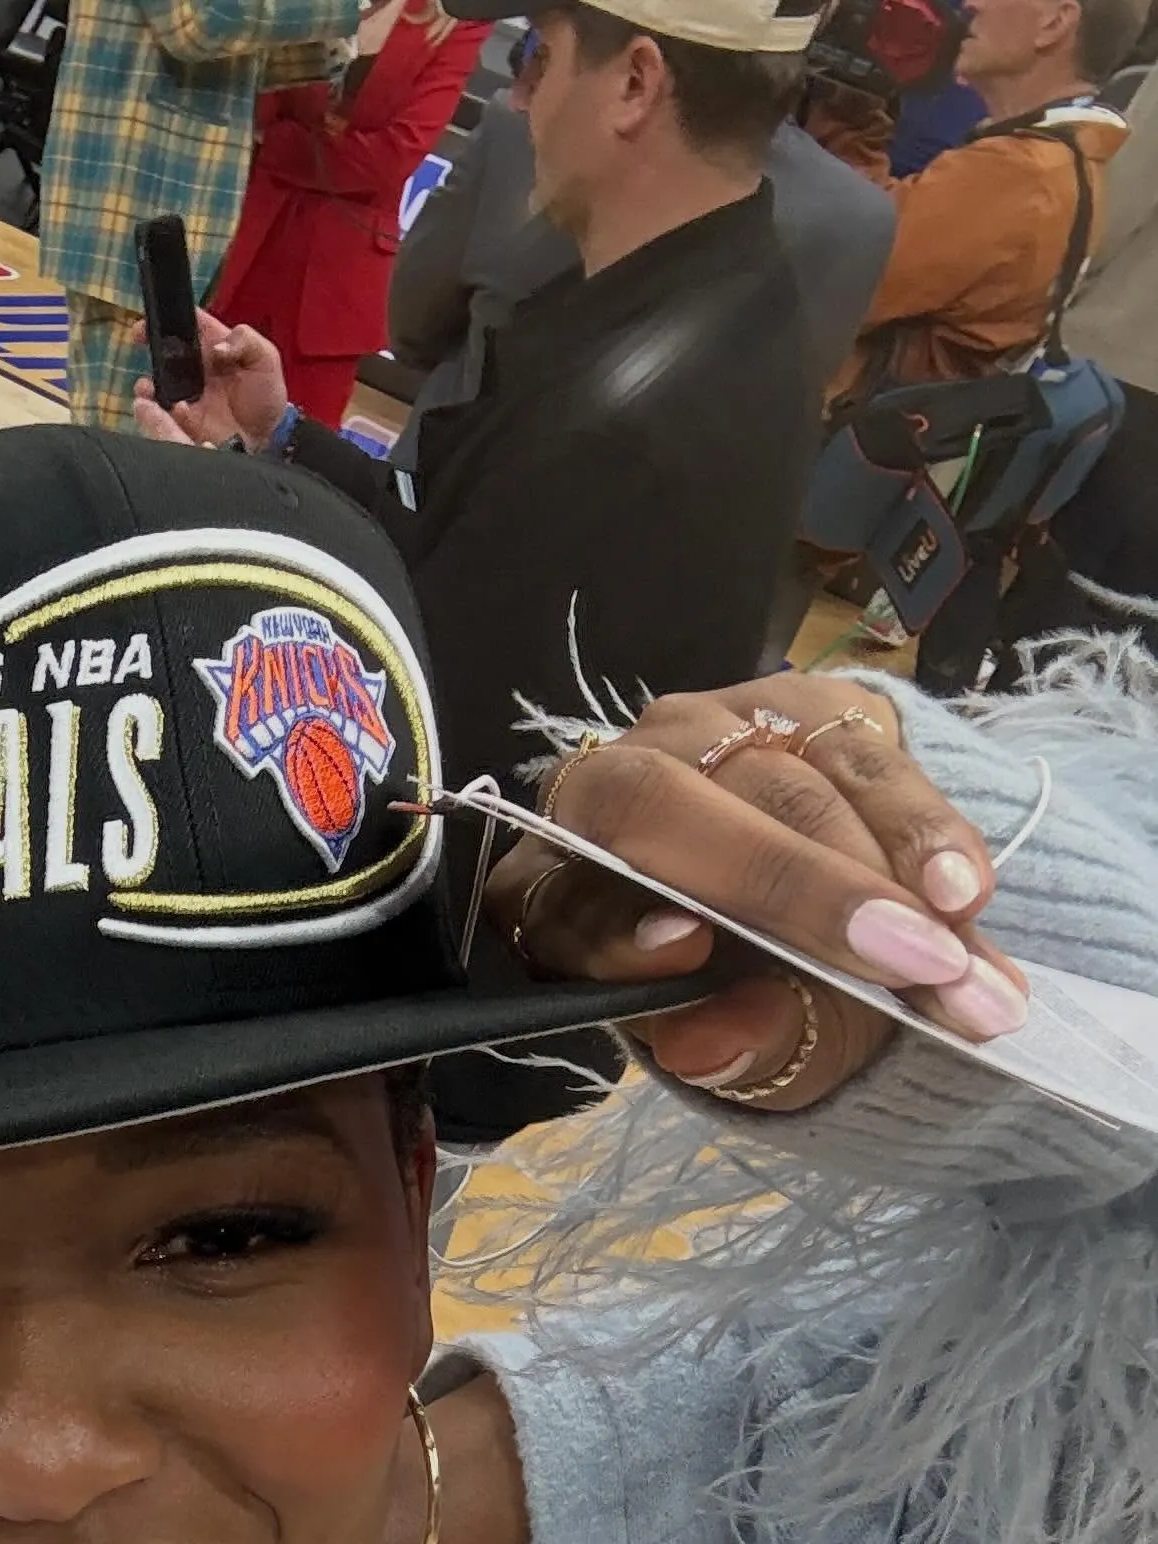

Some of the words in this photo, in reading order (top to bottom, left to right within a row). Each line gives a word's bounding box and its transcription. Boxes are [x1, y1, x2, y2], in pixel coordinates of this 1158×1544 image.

[260, 611, 294, 639] NEW
[32, 633, 153, 693] NBA
[225, 636, 389, 750] KNICKS
